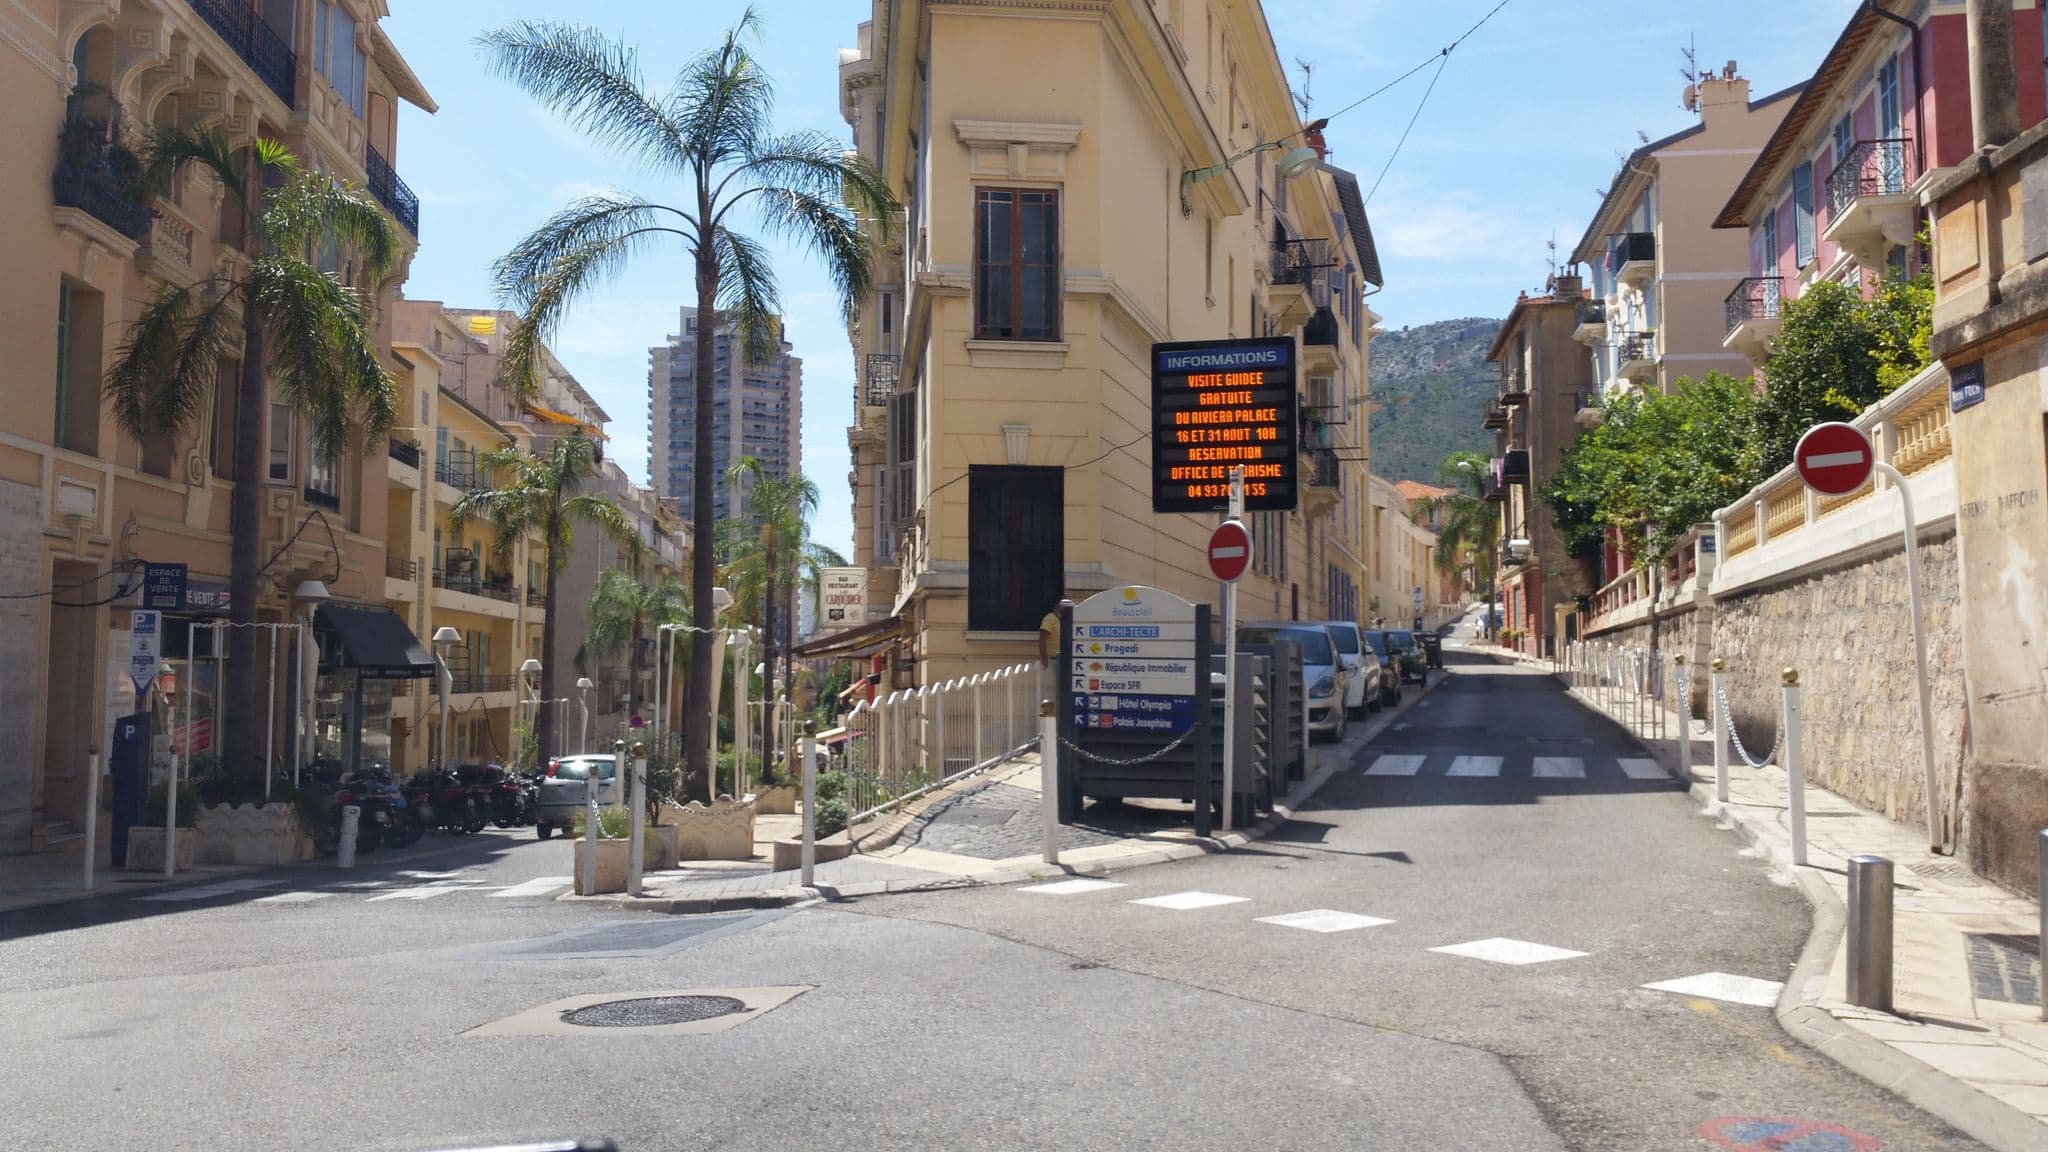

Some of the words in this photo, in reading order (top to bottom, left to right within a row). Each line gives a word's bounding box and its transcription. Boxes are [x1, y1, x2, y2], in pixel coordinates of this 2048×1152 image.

[1168, 351, 1277, 368] INFORMATIONS
[1188, 374, 1223, 387] VISITE
[1225, 372, 1264, 385] GUIDEE
[1200, 391, 1253, 405] GRATUITE
[1176, 412, 1189, 424] DU
[1192, 410, 1233, 423] RIVIERA
[1235, 408, 1276, 422] PALACE
[1176, 430, 1189, 442] 16
[1192, 430, 1205, 442] ET
[1208, 429, 1220, 441] 31
[1223, 428, 1250, 441] AOUT
[1256, 427, 1276, 440] 10H
[1189, 446, 1262, 460] RESERVATION
[1171, 466, 1208, 479] OFFICE
[1211, 466, 1224, 479] DE
[1188, 485, 1201, 497] 04
[1204, 485, 1218, 497] 93
[1252, 483, 1266, 496] 55
[149, 569, 181, 577] ESPACE
[160, 577, 170, 585] DE
[150, 585, 179, 593] VENTE
[194, 592, 214, 606] VENTE
[1112, 607, 1152, 617] Beausoleil
[1091, 627, 1158, 638] L'ARCHI-TECTE
[1105, 643, 1139, 655] Progedi
[1105, 662, 1145, 674] République
[1148, 663, 1187, 674] Immobilier
[1101, 680, 1126, 691] Espace
[1128, 680, 1141, 690] SFR
[1119, 698, 1139, 709] Hôtel
[1140, 700, 1172, 712] Olympia
[1113, 717, 1134, 727] Palais
[125, 725, 135, 739] P
